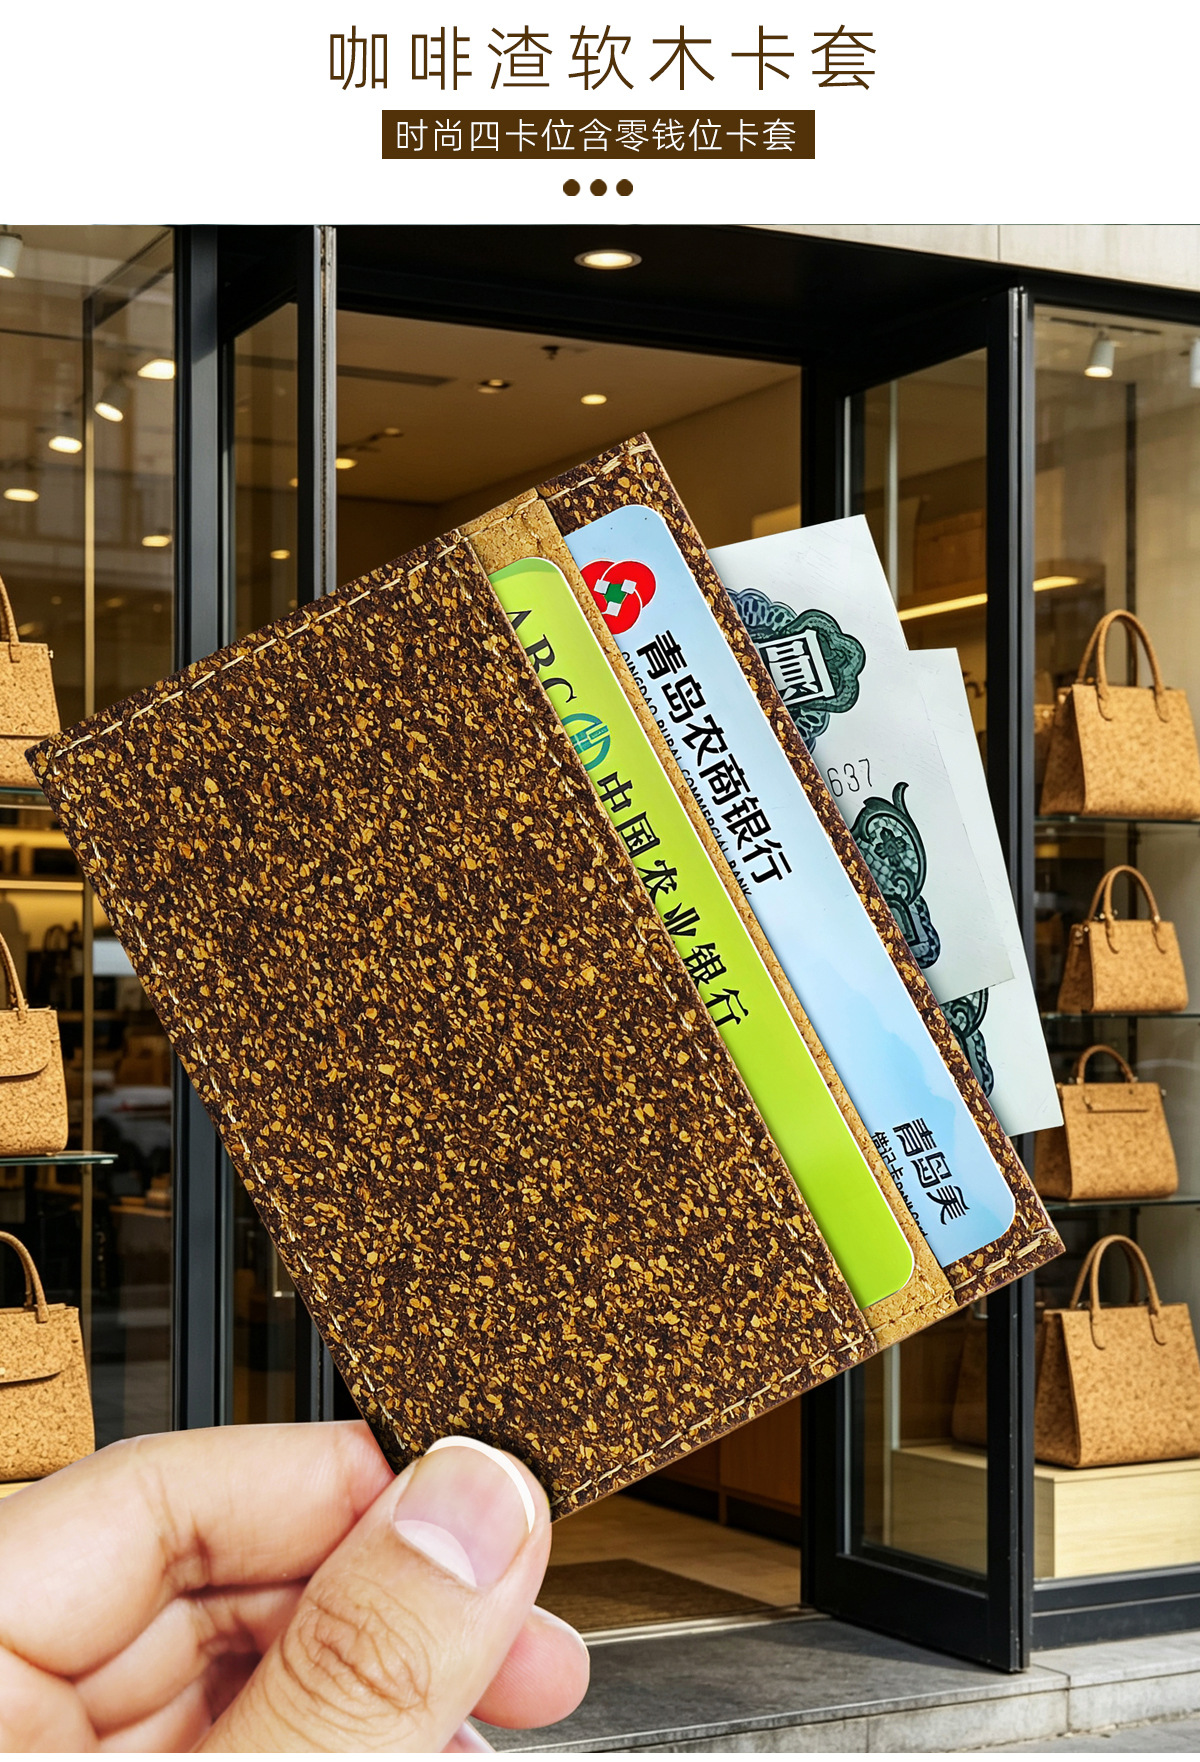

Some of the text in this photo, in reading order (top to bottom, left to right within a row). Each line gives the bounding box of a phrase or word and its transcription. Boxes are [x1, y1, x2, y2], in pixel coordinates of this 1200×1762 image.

[507, 609, 577, 703] ABC
[636, 630, 792, 884] 青岛农商银行
[827, 758, 872, 797] 637
[597, 771, 748, 1027] 中国农业银行
